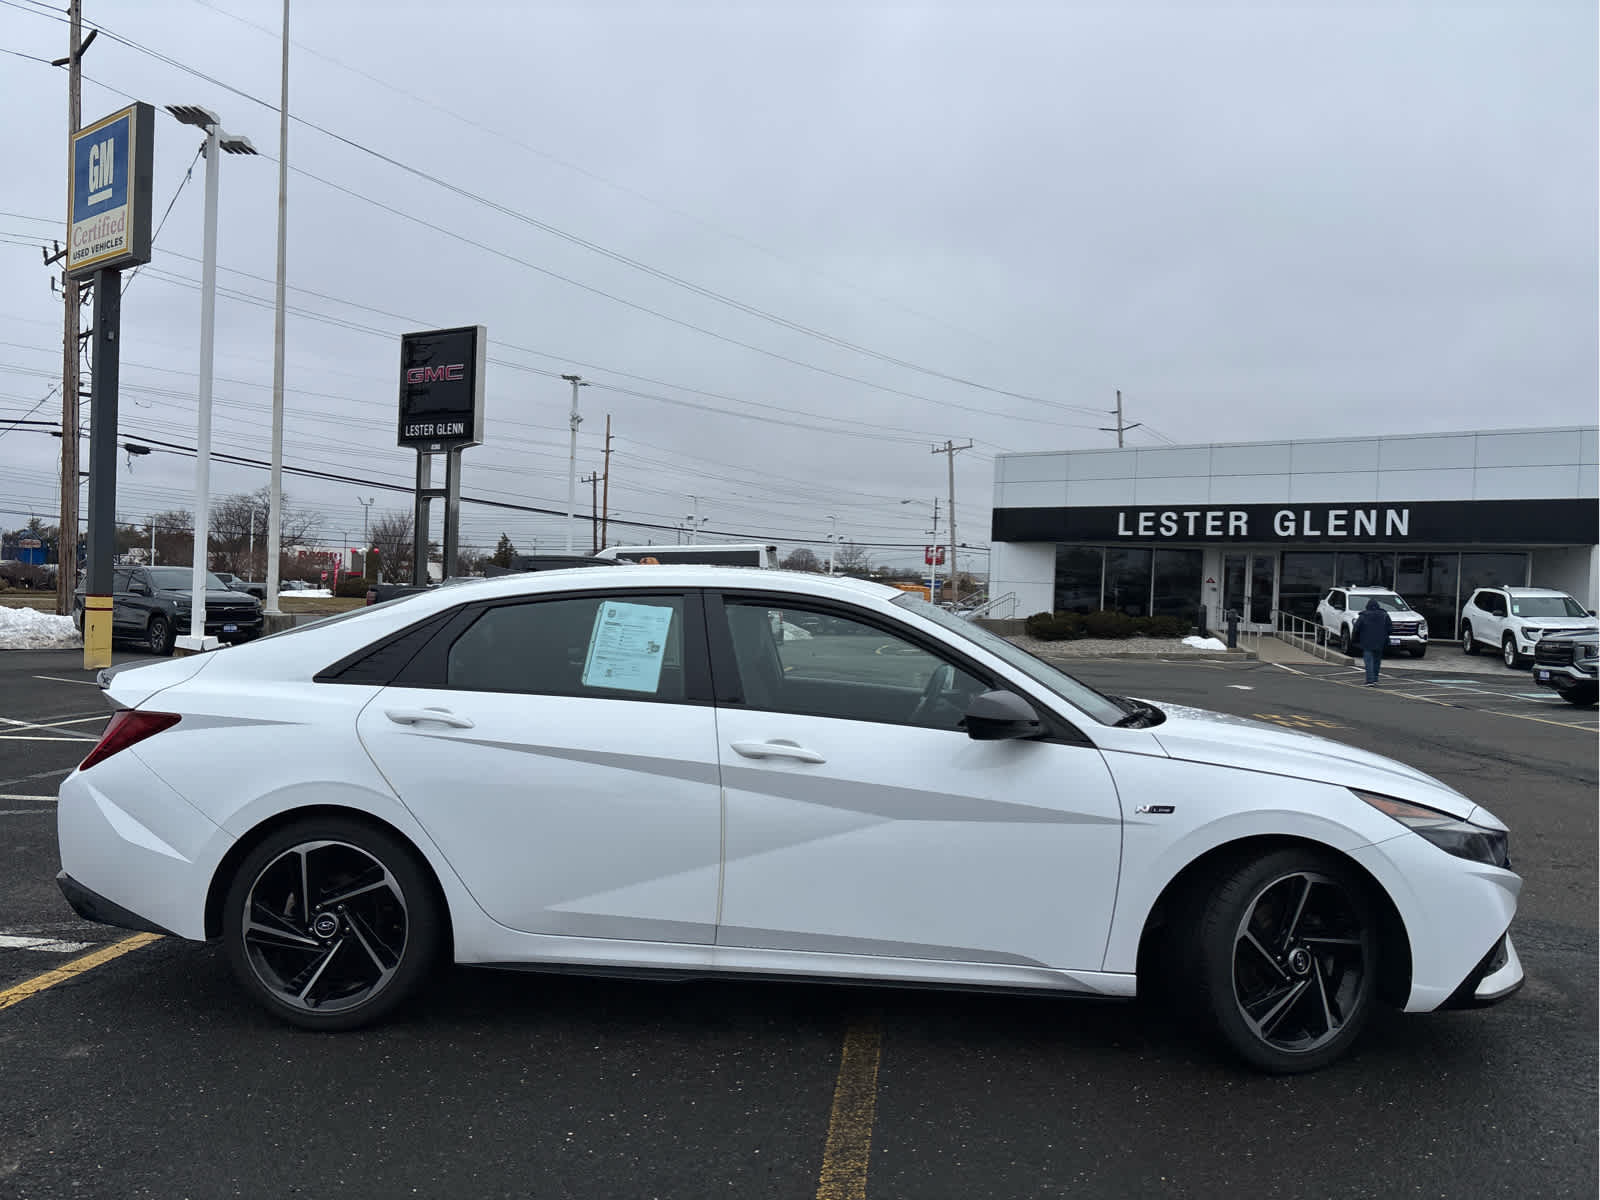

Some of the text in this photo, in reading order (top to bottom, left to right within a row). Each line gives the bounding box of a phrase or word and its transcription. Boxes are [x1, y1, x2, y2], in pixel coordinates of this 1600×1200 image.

[89, 138, 114, 193] GM
[74, 210, 125, 247] Certified
[73, 236, 123, 260] USED VEHICLES
[408, 364, 464, 383] GMC
[405, 423, 464, 436] LESTER GLENN
[1117, 508, 1410, 537] LESTER GLENN
